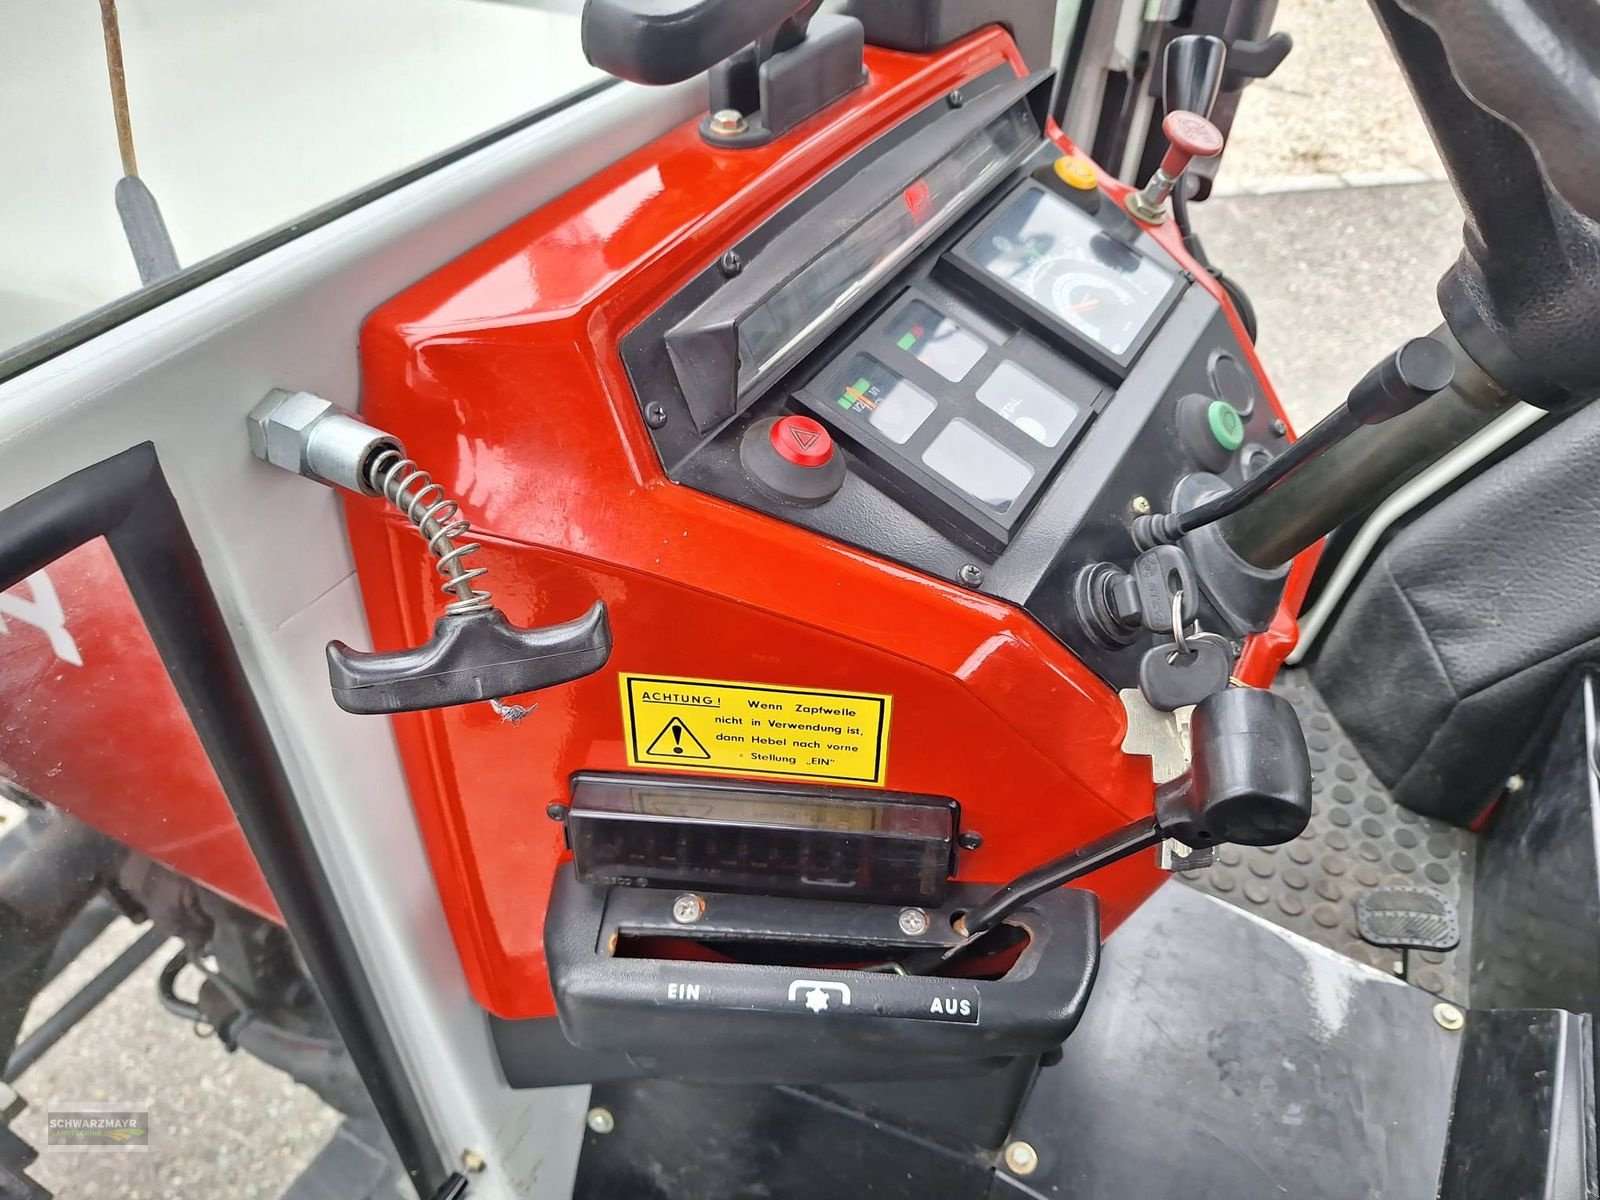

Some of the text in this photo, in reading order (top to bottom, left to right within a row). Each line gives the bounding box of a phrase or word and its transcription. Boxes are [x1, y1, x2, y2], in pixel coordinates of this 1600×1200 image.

[747, 700, 783, 711] Wenn
[795, 703, 857, 718] Zapfwelle
[715, 715, 864, 736] nicht in Verwendung ist,
[715, 733, 859, 752] dann Hebel nach vorne
[751, 752, 797, 765] Stellung
[667, 983, 700, 1000] EIN
[929, 997, 971, 1016] AUS
